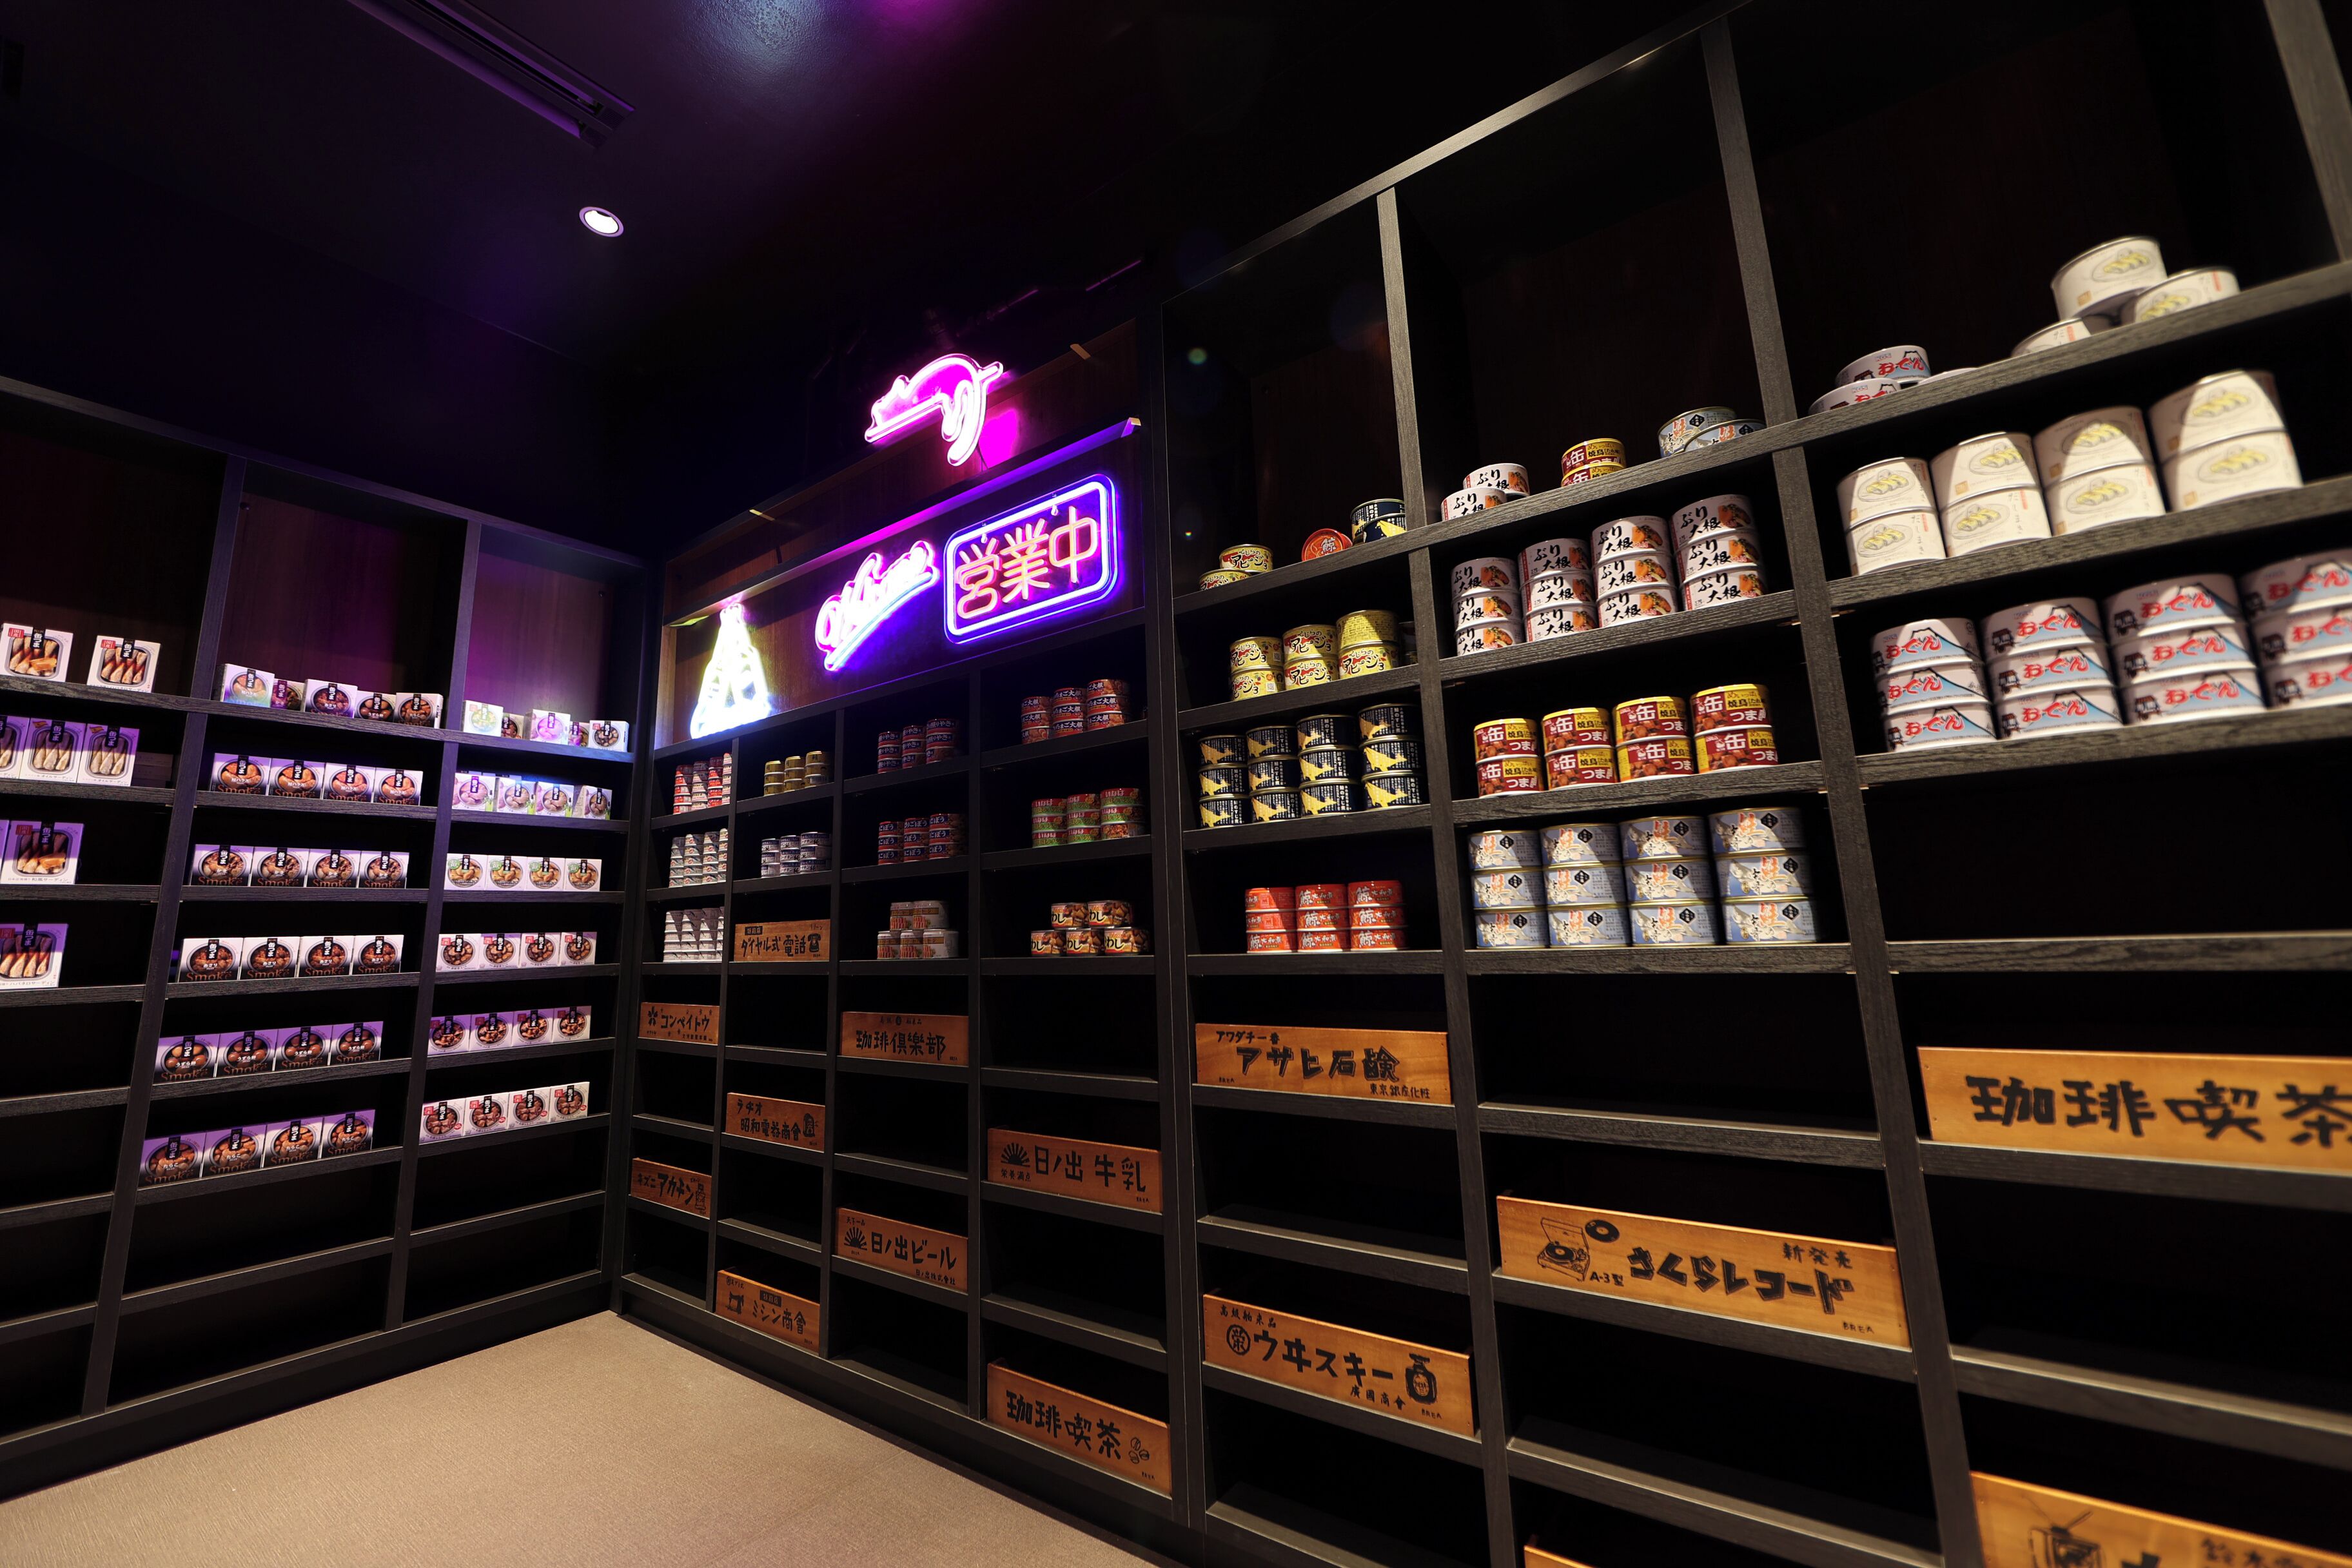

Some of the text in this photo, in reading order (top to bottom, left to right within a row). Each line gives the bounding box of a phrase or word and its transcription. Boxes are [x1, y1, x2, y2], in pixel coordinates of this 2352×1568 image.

[1879, 357, 1925, 375] おでん
[1571, 450, 1585, 464] 缶
[1477, 469, 1500, 485] ぶり
[1488, 480, 1509, 489] 根
[1454, 493, 1476, 509] ぶり
[1681, 506, 1707, 528] ぶり
[1598, 525, 1622, 545] ぶり
[1689, 517, 1721, 538] 大根
[1534, 544, 1560, 562] ぶり
[1604, 538, 1633, 554] 大根
[1689, 539, 1718, 560] ぶり
[957, 505, 1099, 620] 営業中
[1543, 552, 1571, 572] 大根
[1602, 560, 1625, 579] ぶり
[1699, 551, 1732, 570] 大根
[1454, 566, 1473, 583] ぶり
[1608, 572, 1637, 589] 大根
[1698, 573, 1728, 592] ぶり
[1459, 577, 1482, 593] 大根
[1538, 577, 1563, 593] ぶり
[1707, 585, 1741, 603] 大根
[2268, 570, 2349, 600] おでん
[1546, 589, 1574, 602] 大根
[1605, 593, 1629, 611] ぶり
[1457, 597, 1474, 614] ぶり
[1612, 605, 1641, 622] 大根
[2142, 592, 2215, 618] おでん
[1461, 608, 1484, 623] 大根
[1538, 609, 1563, 625] ぶり
[1545, 621, 1574, 636] 大根
[2017, 613, 2082, 637] おでん
[123, 644, 132, 657] 缶つま
[1462, 639, 1484, 655] 大根
[1886, 636, 1941, 658] おでん
[2153, 637, 2227, 662] おでん
[2024, 656, 2088, 678] おでん
[1888, 676, 1942, 699] おでん
[2165, 681, 2240, 704] おでん
[1637, 705, 1656, 720] 缶
[1704, 696, 1723, 712] 缶
[2023, 700, 2088, 722] おでん
[1556, 717, 1573, 732] 缶
[1906, 715, 1964, 736] おでん
[1487, 727, 1504, 741] 缶
[1725, 734, 1746, 750] 缶
[1645, 743, 1665, 759] 缶
[1559, 754, 1576, 769] 缶
[1487, 764, 1502, 778] 缶
[42, 828, 51, 843] 缶つま
[661, 1014, 710, 1032] コンペイトウ
[1216, 1030, 1280, 1045] アワダチ一番
[1370, 1083, 1430, 1099] 東京銀座化粧
[1965, 1075, 2352, 1148] 珈琲喫茶
[872, 1231, 957, 1270] 日ノ出ビール
[1783, 1241, 1854, 1269] 新発売
[1627, 1246, 1856, 1315] さくらレコード
[1253, 1329, 1394, 1387] ウヰスキー
[1006, 1389, 1121, 1460] 珈琲喫茶
